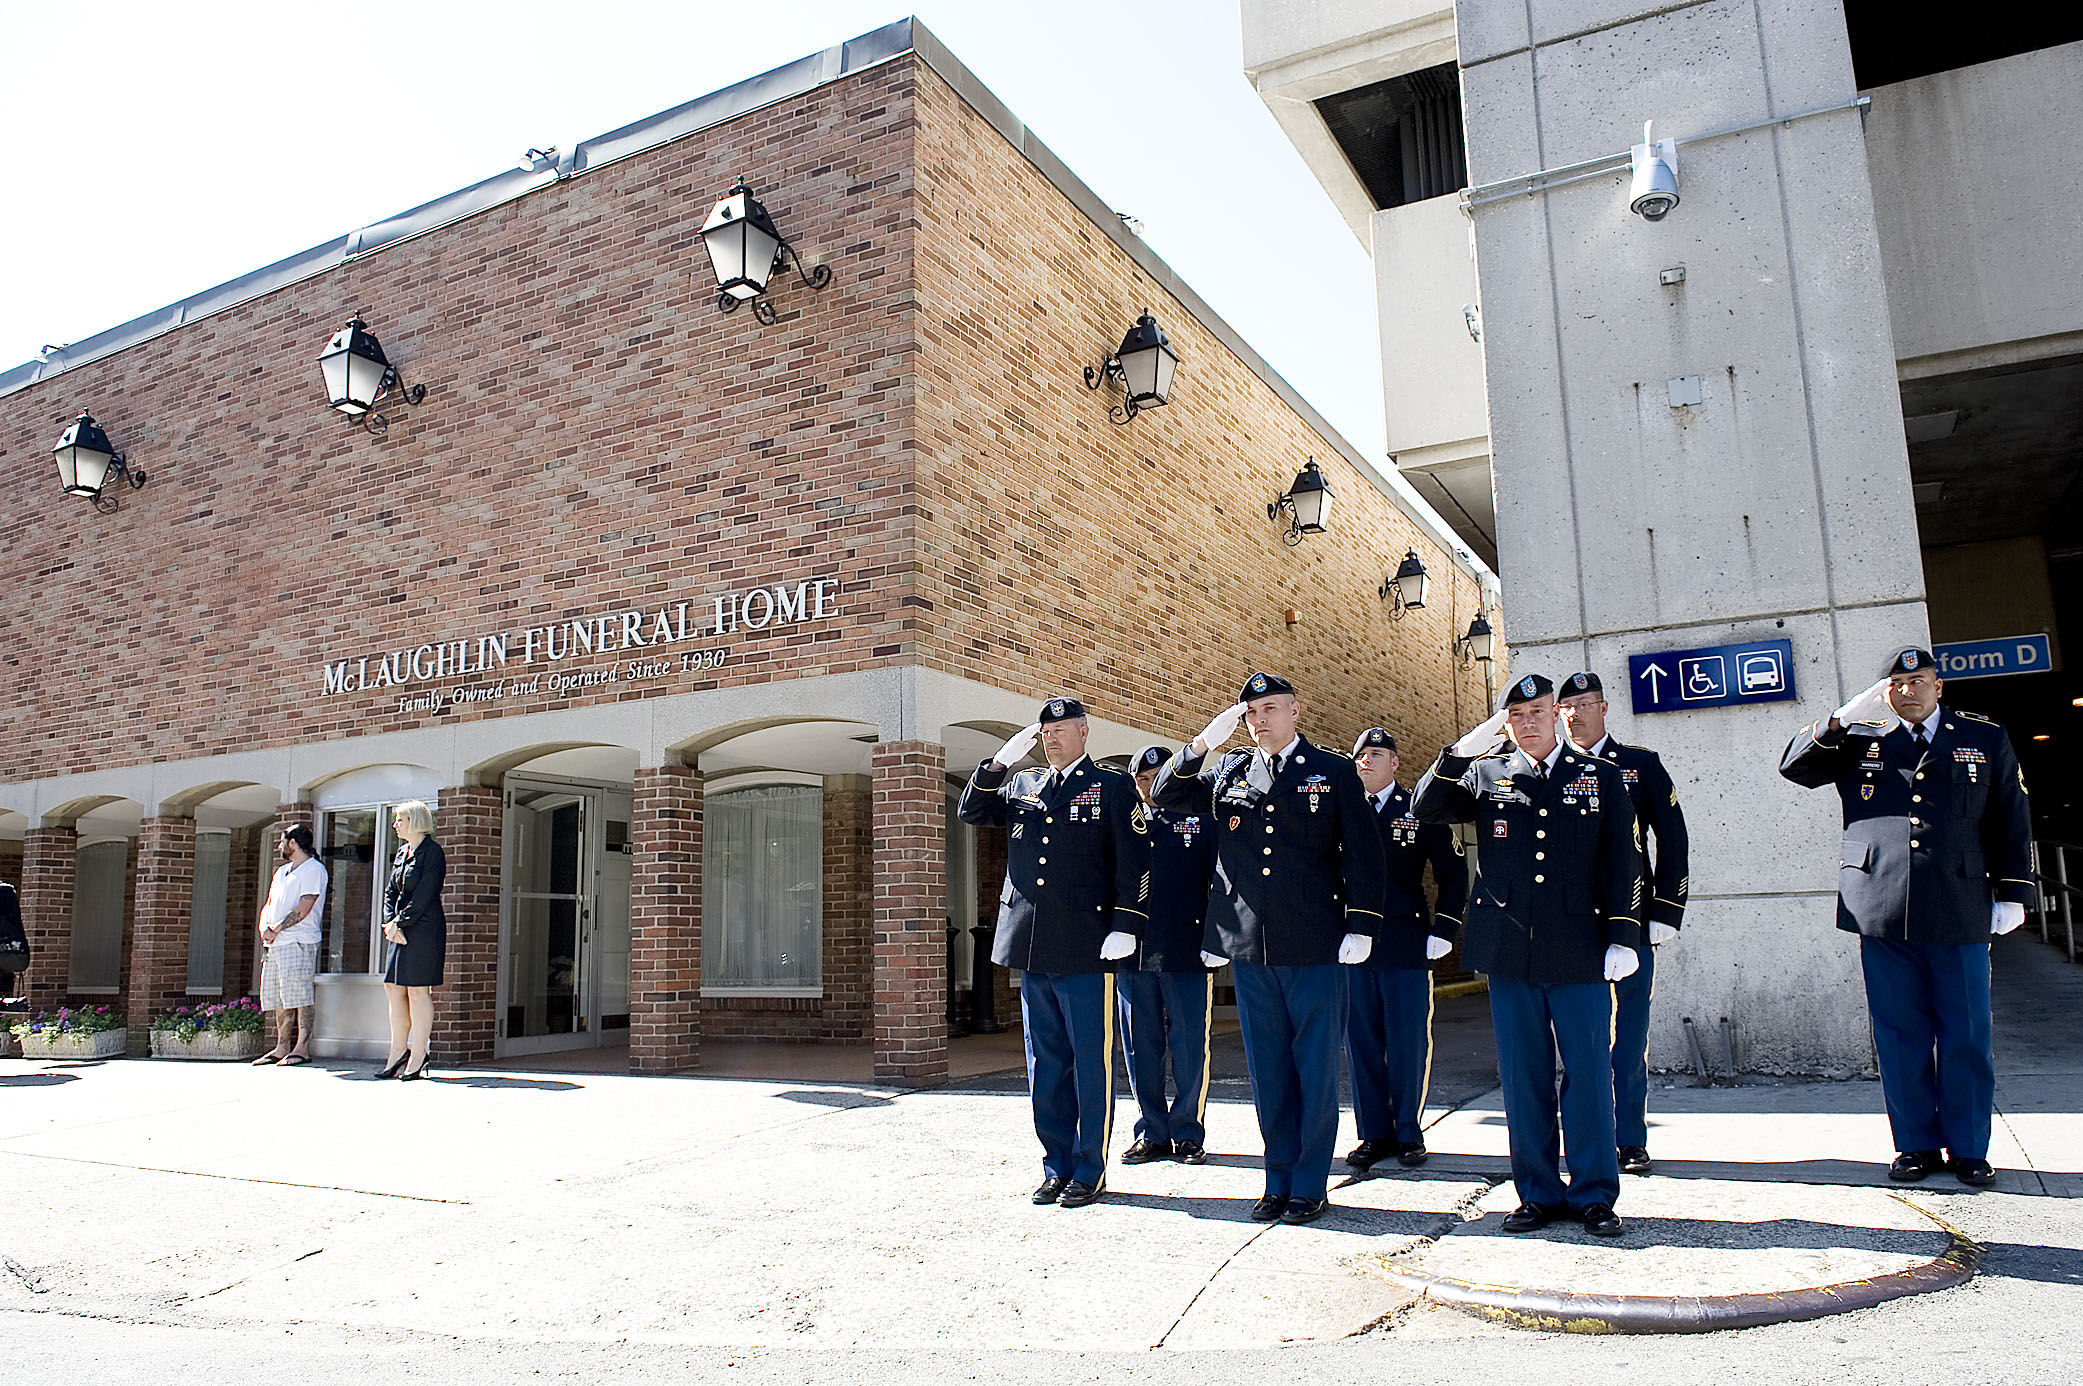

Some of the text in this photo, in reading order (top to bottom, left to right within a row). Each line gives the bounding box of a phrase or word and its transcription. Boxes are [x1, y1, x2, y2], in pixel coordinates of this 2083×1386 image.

[321, 578, 840, 696] McLAUGHLIN FUNERAL HOME
[2016, 644, 2037, 665] D
[399, 649, 726, 714] Family Owned and Operated Since 1930
